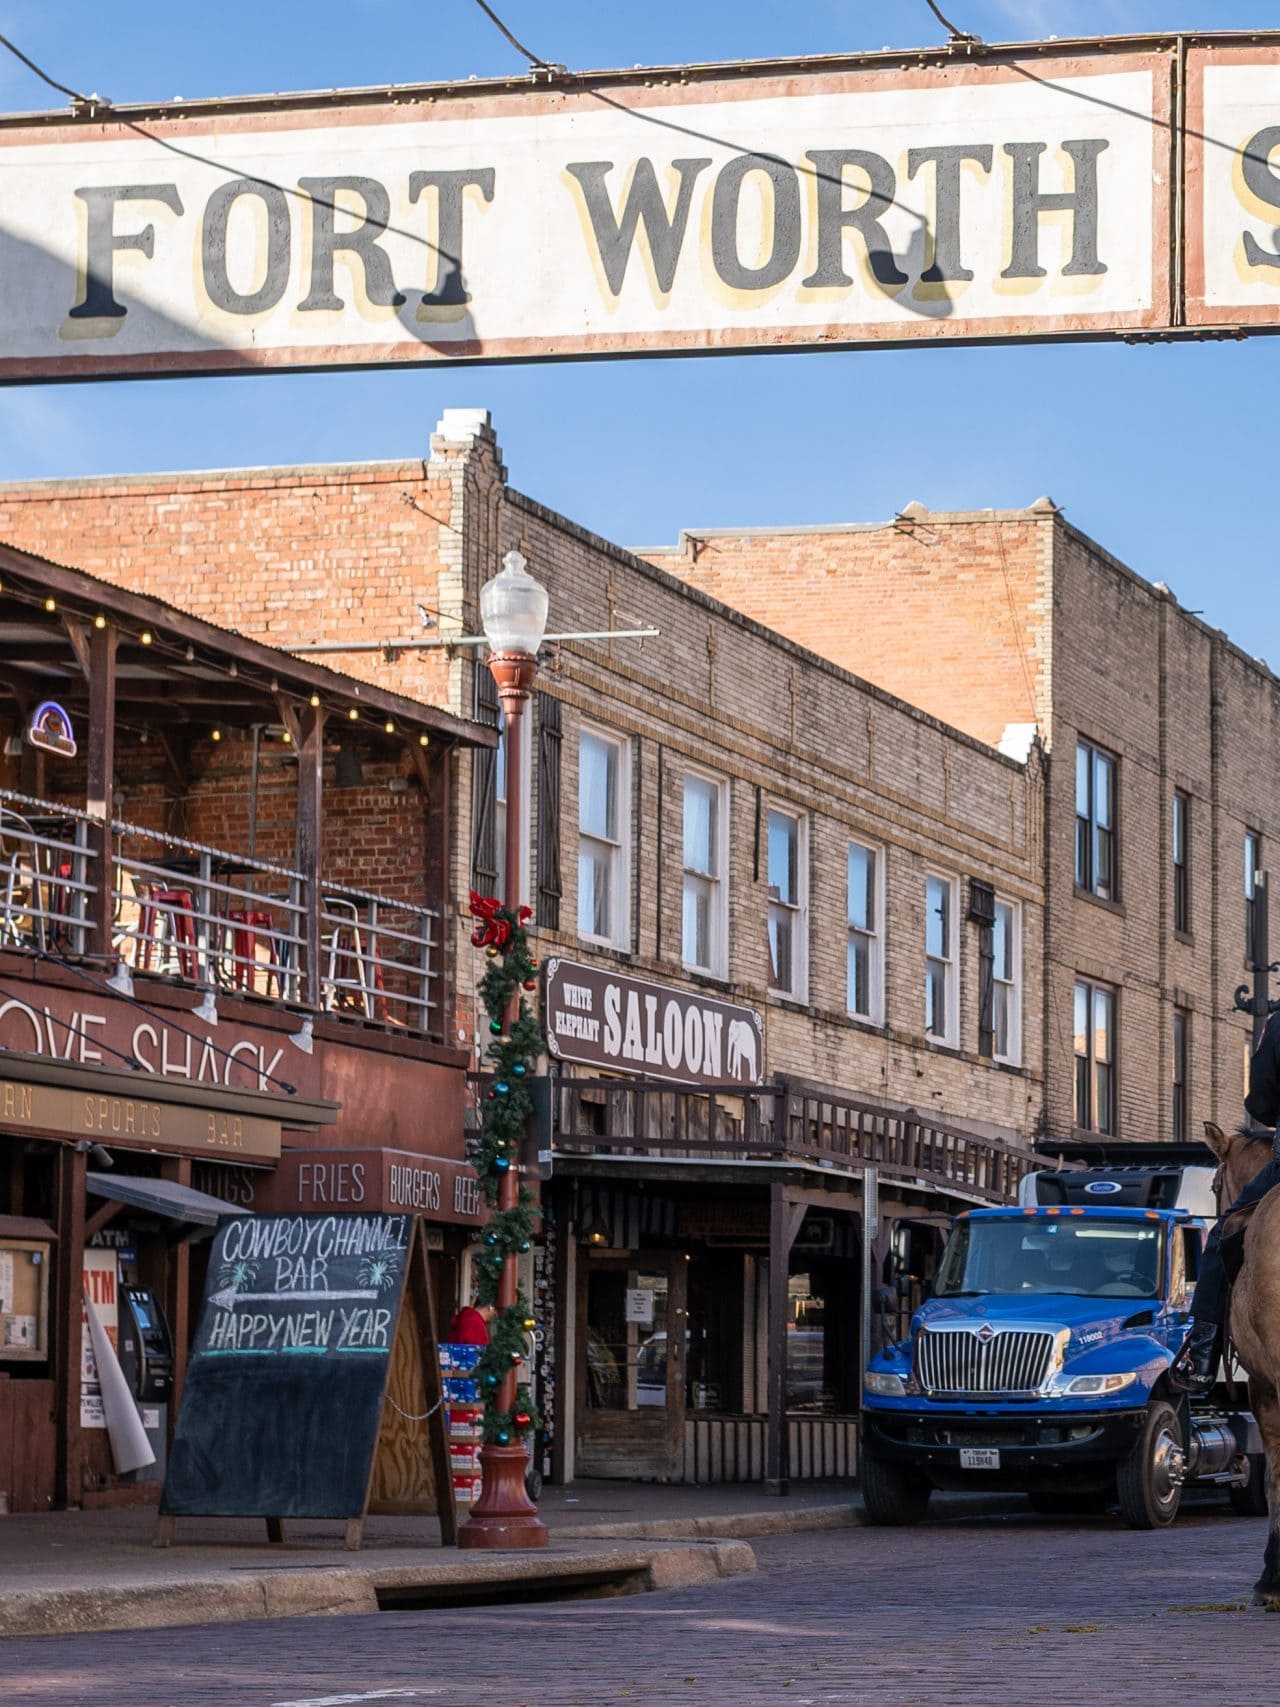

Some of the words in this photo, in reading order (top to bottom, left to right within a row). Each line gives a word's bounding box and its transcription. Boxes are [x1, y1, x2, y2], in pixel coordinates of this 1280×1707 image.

[67, 166, 497, 321] FORT
[565, 139, 1110, 297] WORTH
[562, 982, 593, 1012] WHITE
[555, 1011, 600, 1043] ELEPHANT
[603, 983, 724, 1079] SALOON
[132, 1023, 284, 1092] SHACK
[84, 1095, 162, 1137] SPORTS
[207, 1113, 244, 1148] BAR
[298, 1162, 366, 1203] FRIES
[389, 1164, 441, 1212] BURGERS
[91, 1230, 129, 1247] ATM
[221, 1216, 320, 1262] COWBOY
[317, 1216, 408, 1257] CHANNEL
[274, 1256, 329, 1295] BAR
[207, 1311, 285, 1349] HAPPY
[282, 1308, 334, 1347] NEW
[336, 1307, 391, 1350] YEAR
